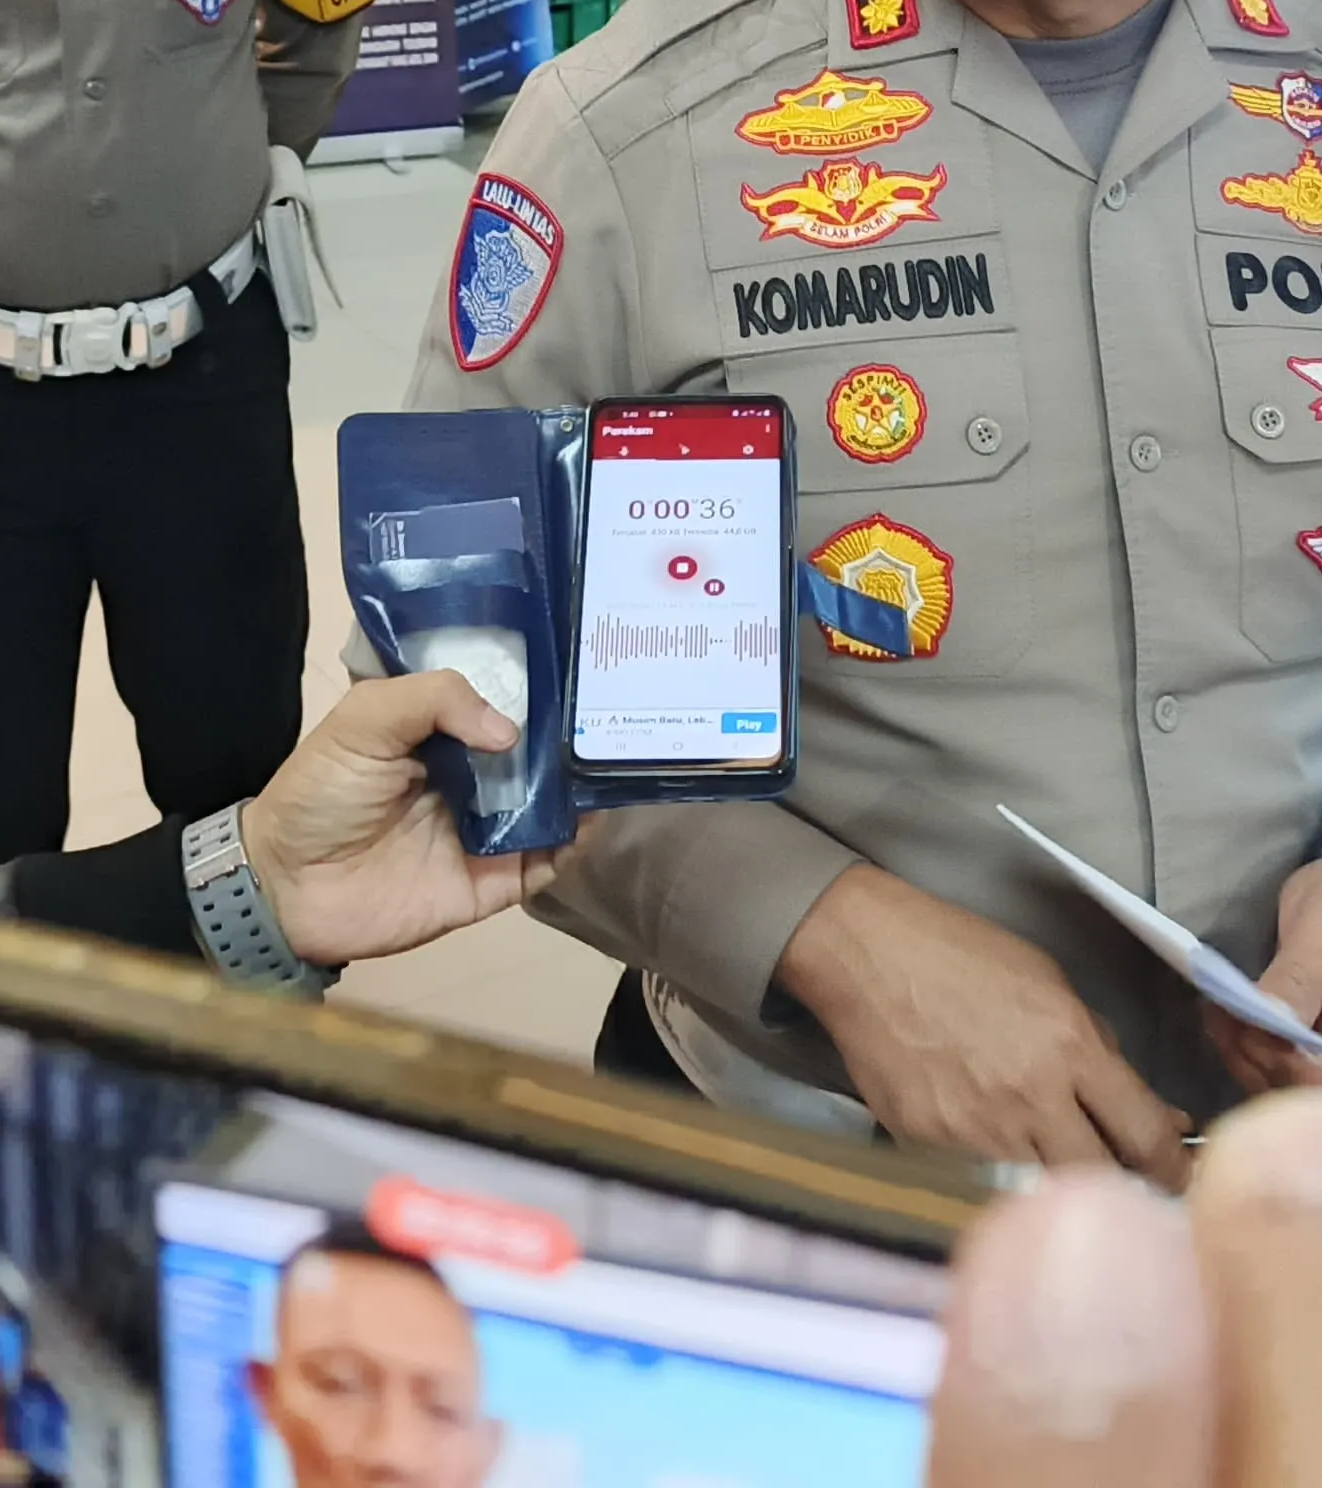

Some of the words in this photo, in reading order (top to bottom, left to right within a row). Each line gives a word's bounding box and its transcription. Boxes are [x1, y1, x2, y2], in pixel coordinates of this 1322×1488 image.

[799, 125, 876, 147] PENYIDIK
[809, 220, 850, 240] SELAM
[853, 213, 888, 239] POLRI
[733, 253, 995, 336] KOMARUDIN
[653, 498, 691, 520] 00
[699, 498, 736, 520] 36
[736, 718, 763, 733] Play
